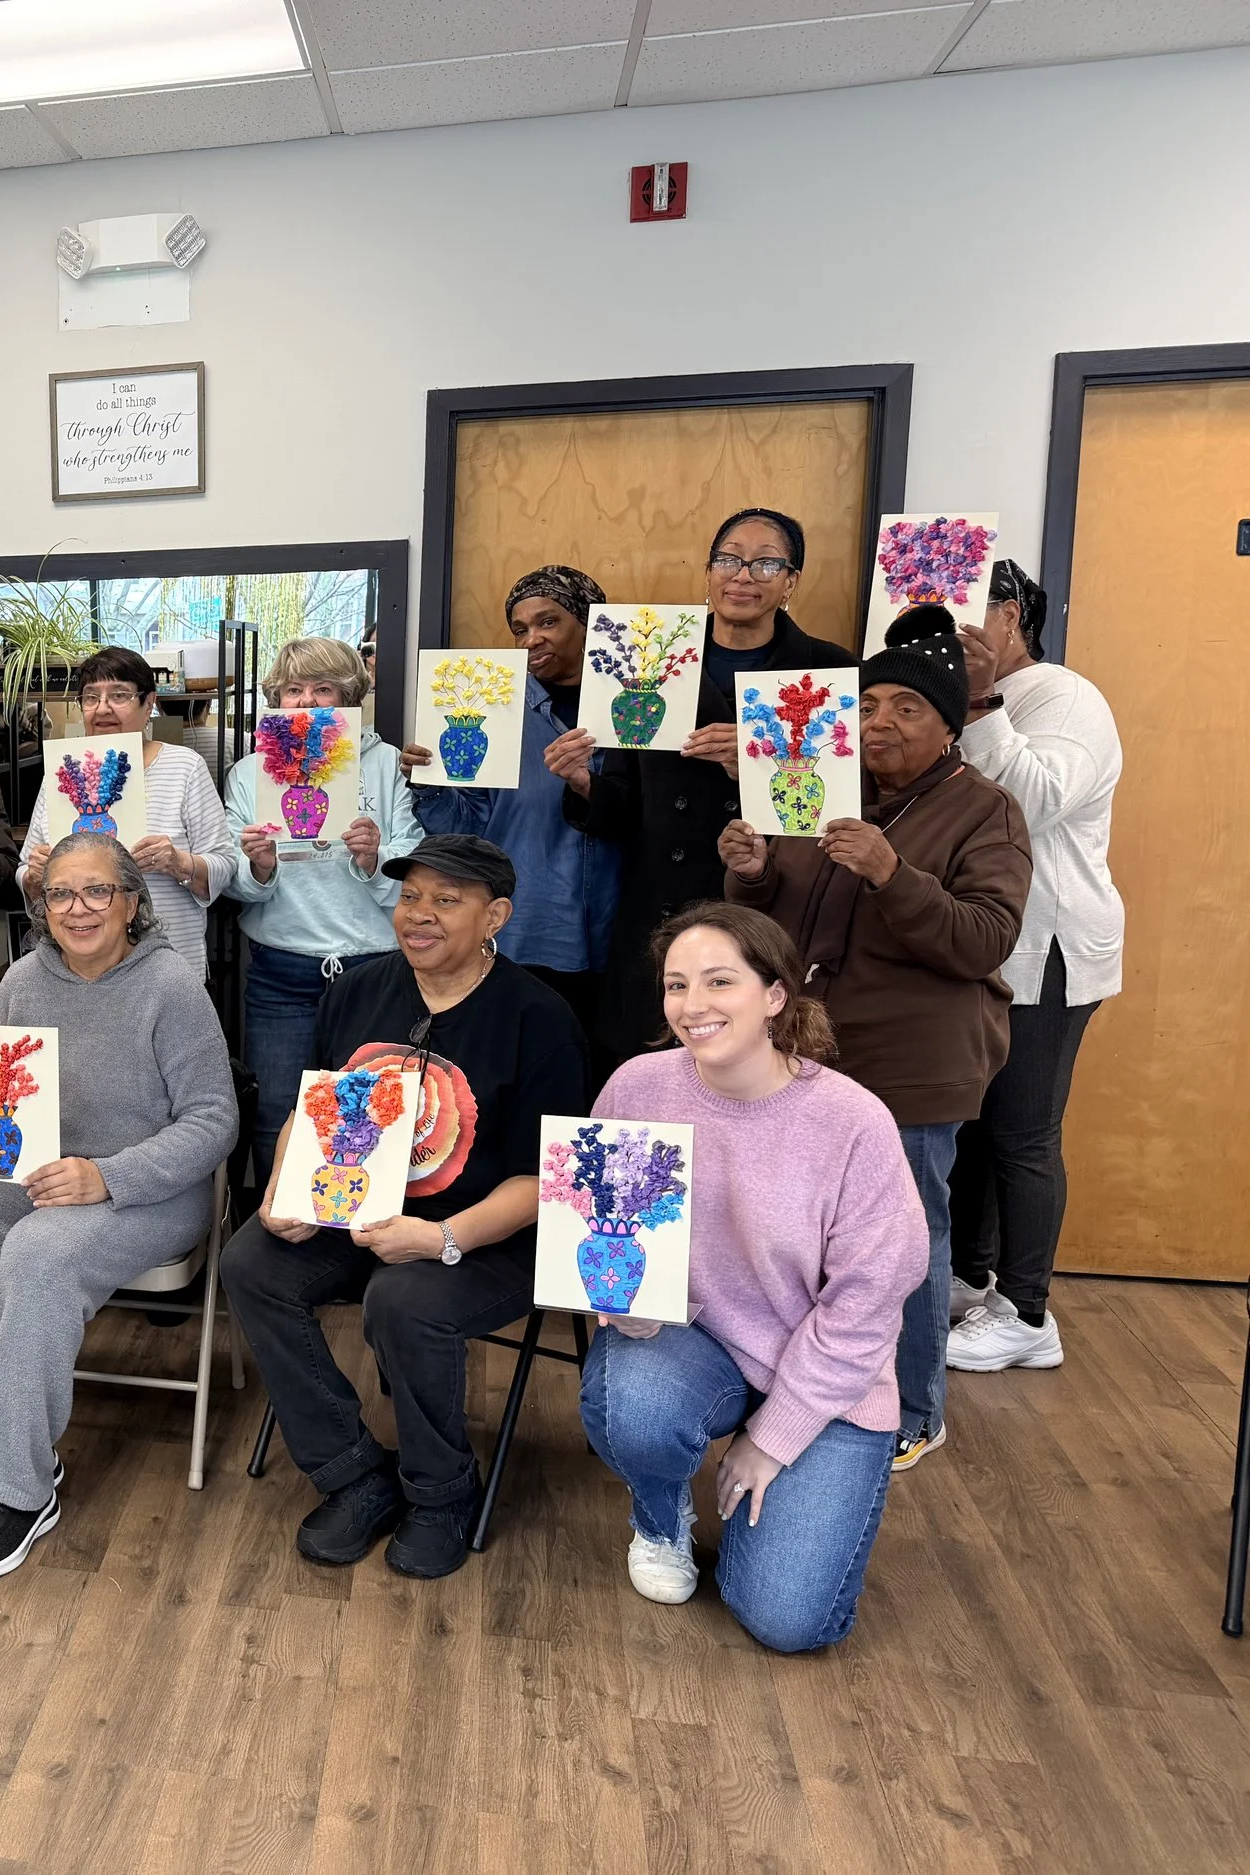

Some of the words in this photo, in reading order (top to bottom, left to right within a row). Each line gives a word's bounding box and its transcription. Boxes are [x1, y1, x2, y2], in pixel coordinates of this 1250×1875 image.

[111, 383, 117, 394] I
[118, 383, 137, 394] can
[96, 399, 109, 411] do
[110, 397, 123, 409] all
[125, 395, 157, 409] things
[60, 416, 126, 446] through
[126, 411, 196, 440] Christ
[62, 450, 89, 468] who
[88, 445, 170, 472] strengthens
[172, 447, 193, 458] me
[103, 475, 138, 485] Philippians
[138, 473, 153, 482] 4:13
